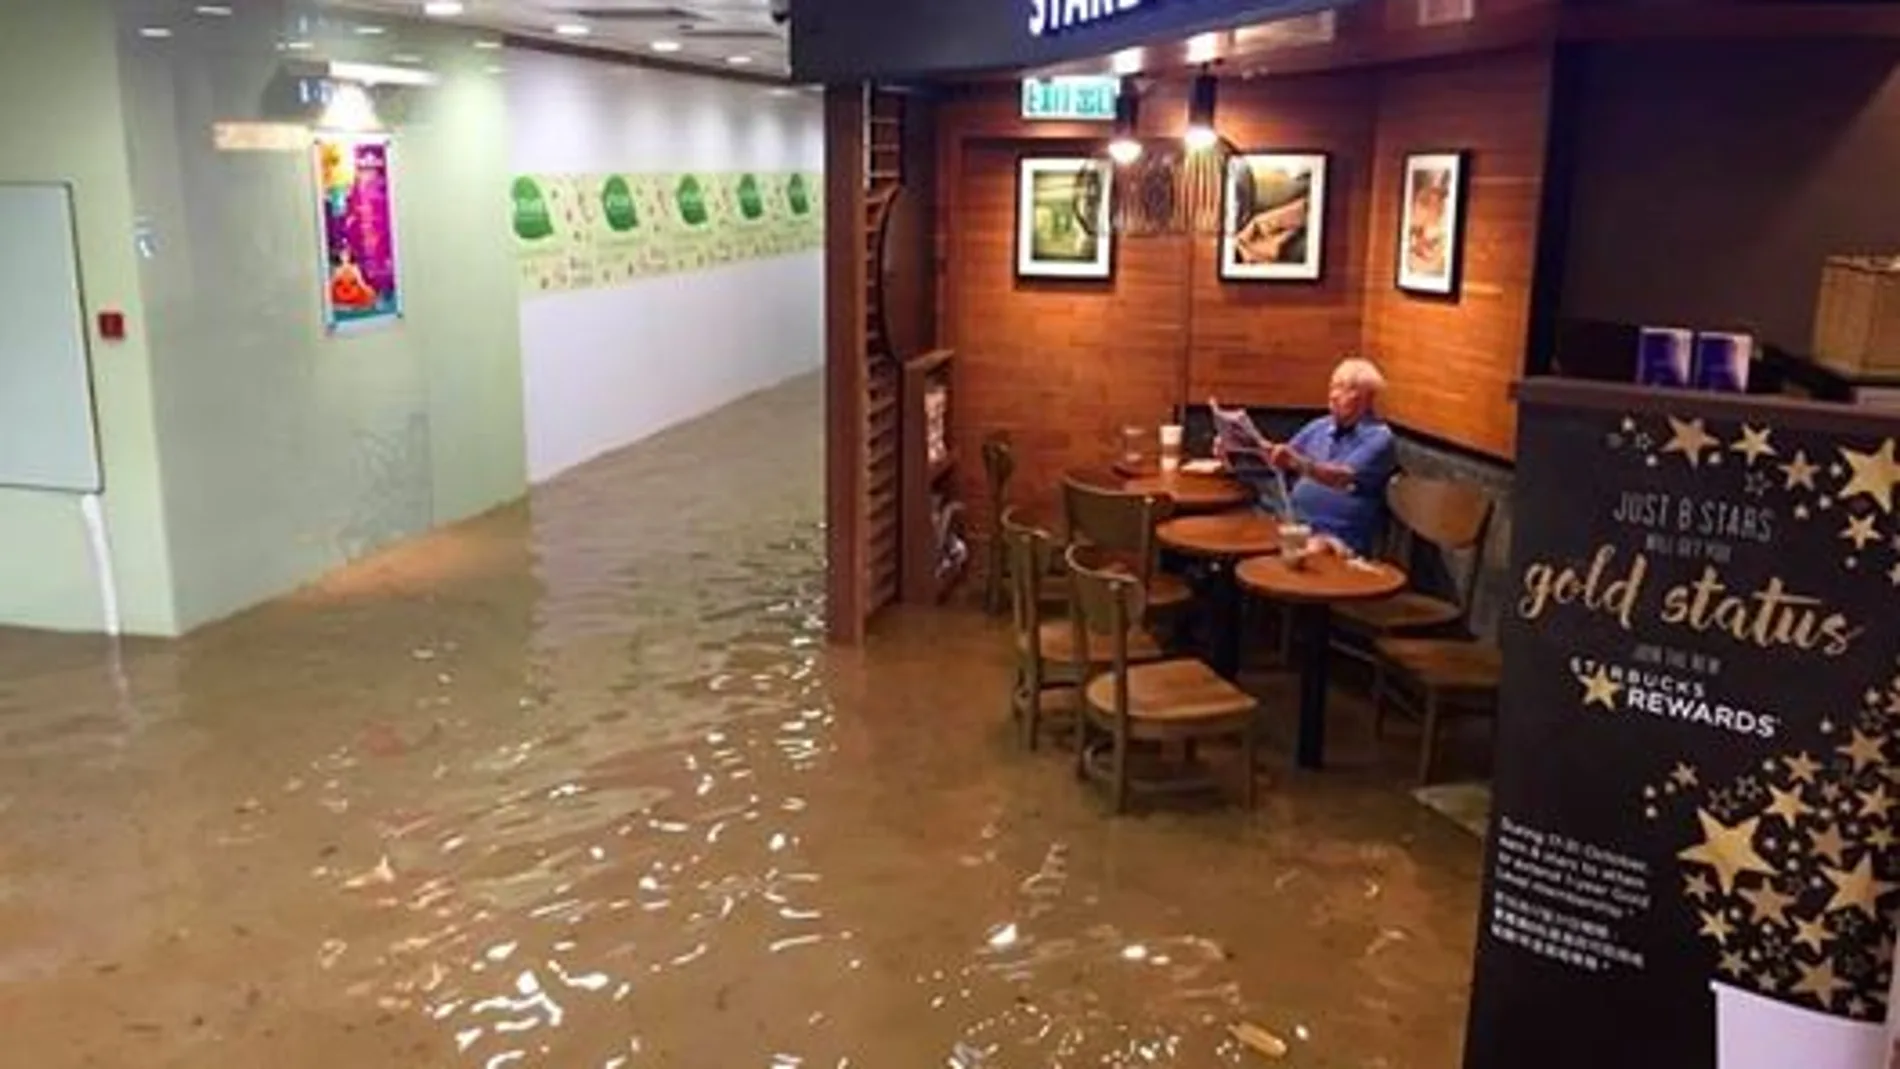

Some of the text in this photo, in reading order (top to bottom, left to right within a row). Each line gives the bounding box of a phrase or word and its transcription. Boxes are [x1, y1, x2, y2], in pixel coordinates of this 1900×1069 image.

[1613, 490, 1671, 529] JUST
[1697, 498, 1776, 543] STARS
[1519, 543, 1865, 656] gold status
[1569, 655, 1706, 699] STRBUCKS
[1626, 687, 1777, 739] REWARDS
